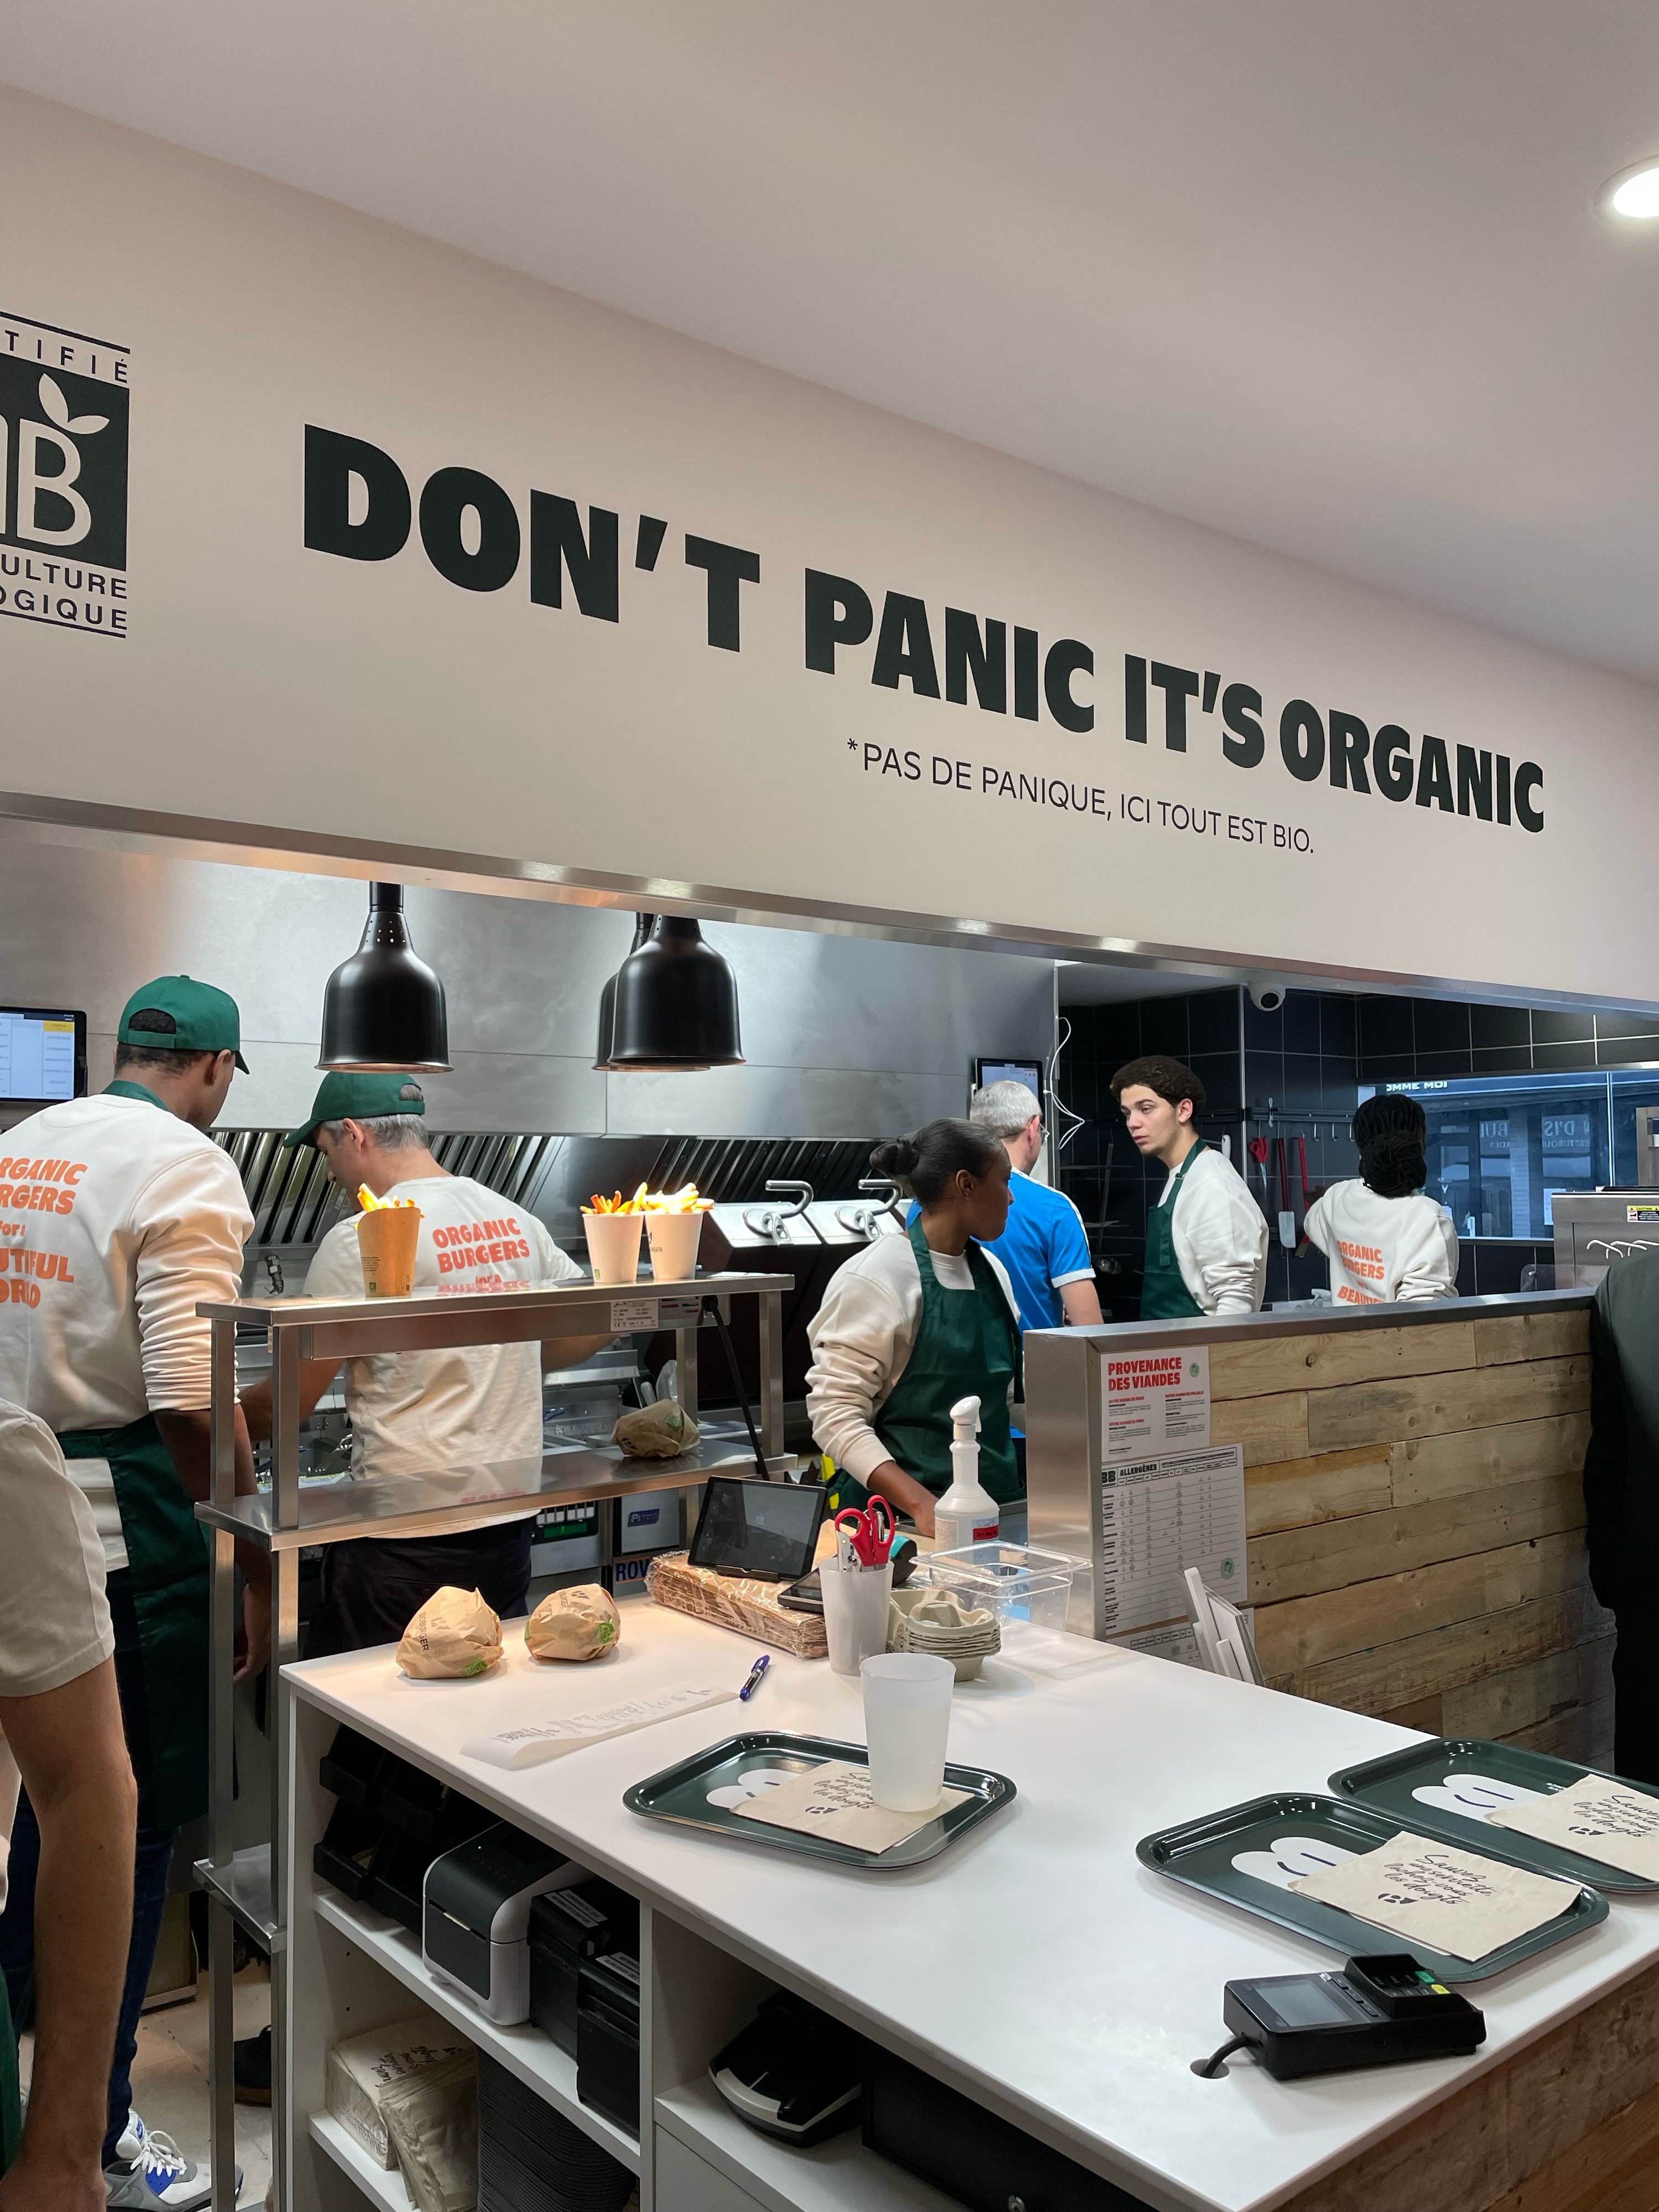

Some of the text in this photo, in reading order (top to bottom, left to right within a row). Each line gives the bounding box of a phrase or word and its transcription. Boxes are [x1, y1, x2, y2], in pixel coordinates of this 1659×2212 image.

[0, 414, 92, 546] B
[304, 424, 1544, 833] DON'T PANIC IT'S ORGANIC
[932, 756, 972, 790] DE
[983, 766, 1112, 822] PANIQUE,
[1121, 794, 1150, 823] ICI
[1157, 801, 1222, 836] TOUT
[1228, 815, 1267, 844] EST
[1274, 823, 1314, 854] BIO.
[0, 1157, 88, 1185] RGANIC
[0, 1184, 76, 1215] RGERS
[432, 1218, 521, 1248] ORGANIC
[437, 1239, 530, 1274] BURGERS
[1337, 1240, 1383, 1263] ORGANIC
[1108, 1357, 1182, 1376] PROVENANCE
[1108, 1373, 1180, 1391] DES VIANDES
[1120, 1463, 1157, 1477] ALLERGÈNES
[1416, 1855, 1486, 1882] Sauvez
[1403, 1883, 1471, 1904] doigts
